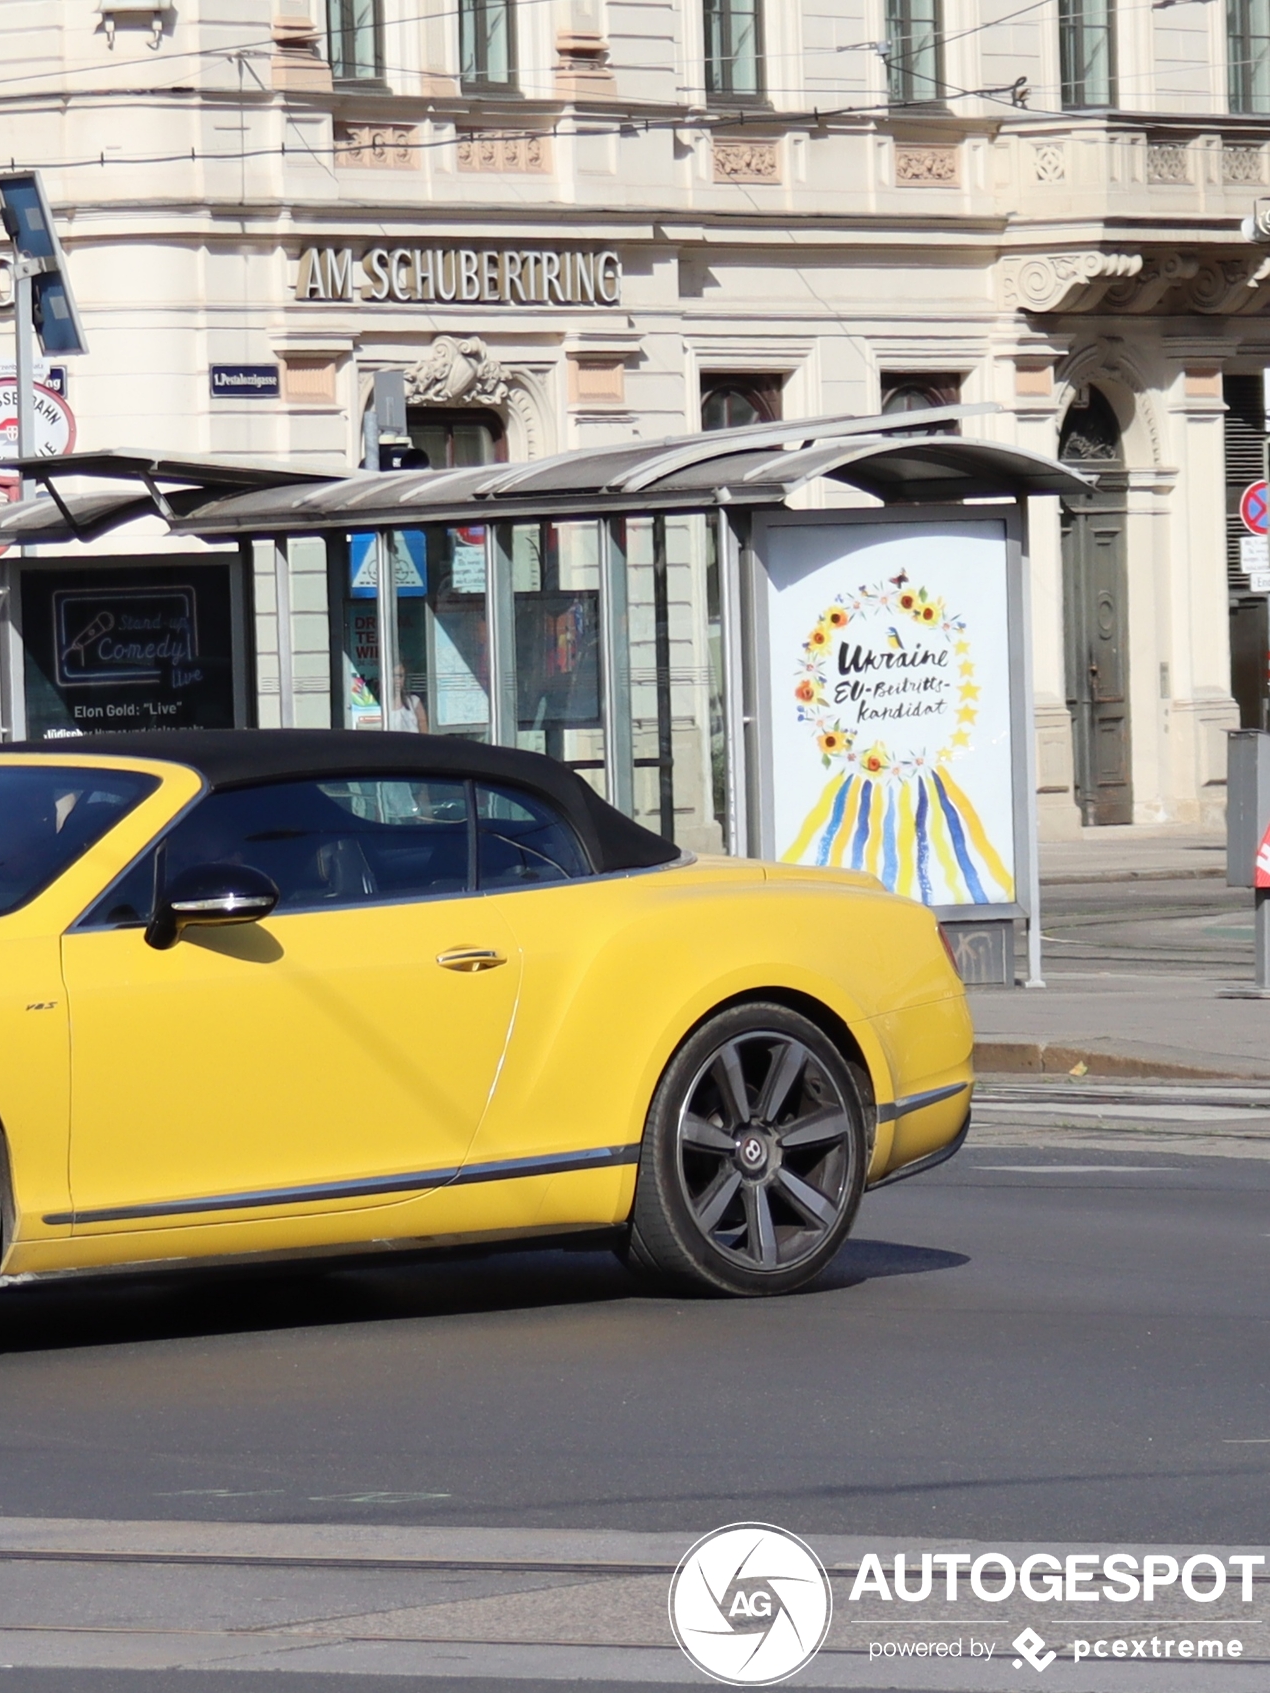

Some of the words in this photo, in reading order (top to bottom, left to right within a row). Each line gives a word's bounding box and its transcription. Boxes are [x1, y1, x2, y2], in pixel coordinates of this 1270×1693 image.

[297, 248, 353, 300] AM
[364, 249, 623, 304] SCHUBERTRING
[97, 633, 186, 667] Comedy
[837, 640, 949, 676] Ukraine
[74, 705, 104, 718] Elon
[106, 703, 140, 717] Gold:
